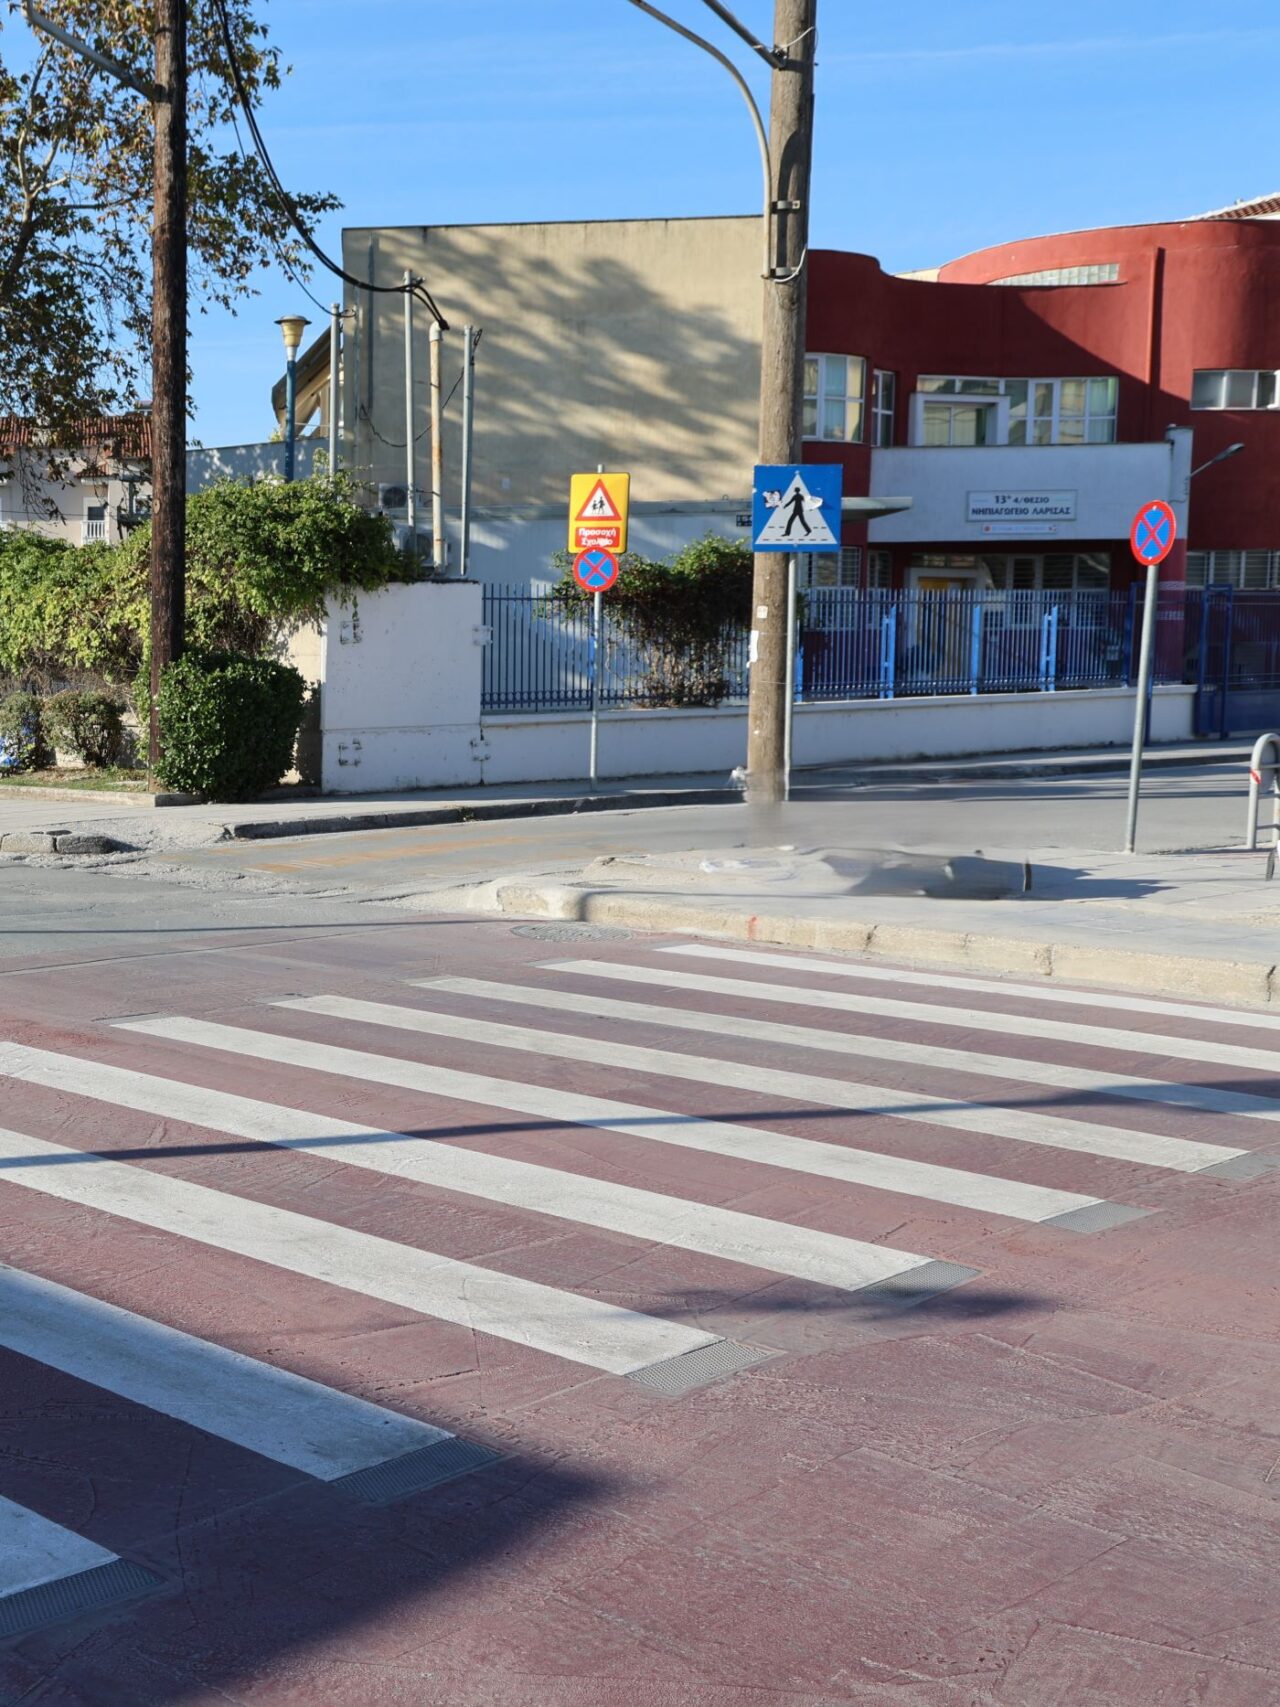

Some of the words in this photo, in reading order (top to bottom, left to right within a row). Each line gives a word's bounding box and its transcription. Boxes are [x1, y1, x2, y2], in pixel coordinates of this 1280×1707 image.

[971, 507, 1029, 516] ΝΗΠΙΑΓΩΓΕΙΟ
[1031, 506, 1071, 515] ΛΑΡΙΣΑΣ
[578, 527, 616, 537] Προσοχή
